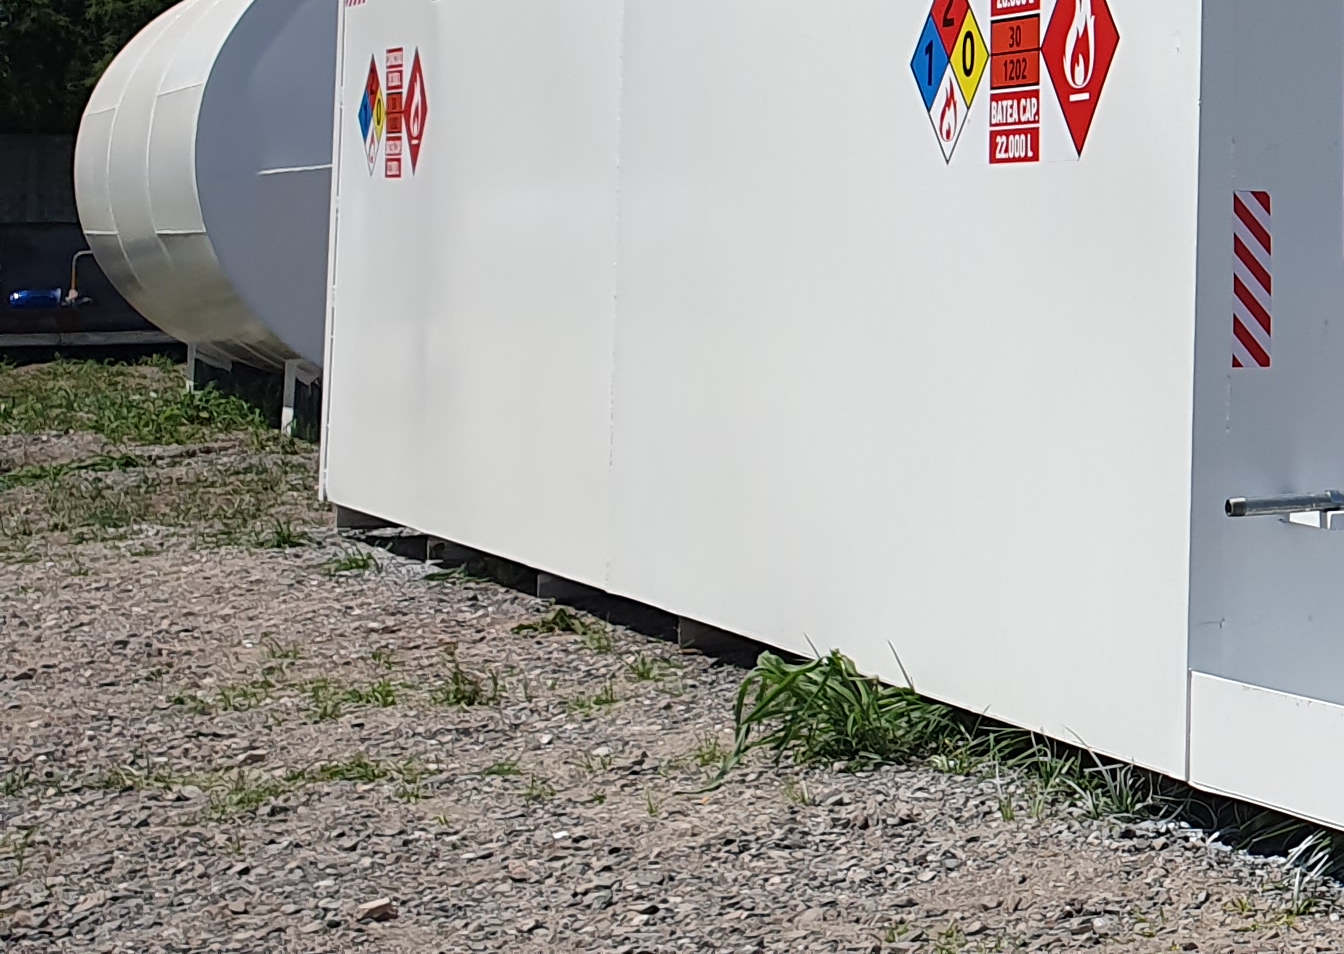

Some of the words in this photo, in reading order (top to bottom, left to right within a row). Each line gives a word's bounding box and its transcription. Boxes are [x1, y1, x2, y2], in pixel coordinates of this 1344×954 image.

[1009, 25, 1021, 48] 30
[925, 40, 934, 86] 1
[962, 30, 975, 78] 0
[1003, 57, 1027, 81] 1202
[991, 100, 1018, 124] BATEA
[1020, 97, 1038, 121] CAP.
[996, 134, 1025, 159] 22.000
[1027, 134, 1033, 157] L
